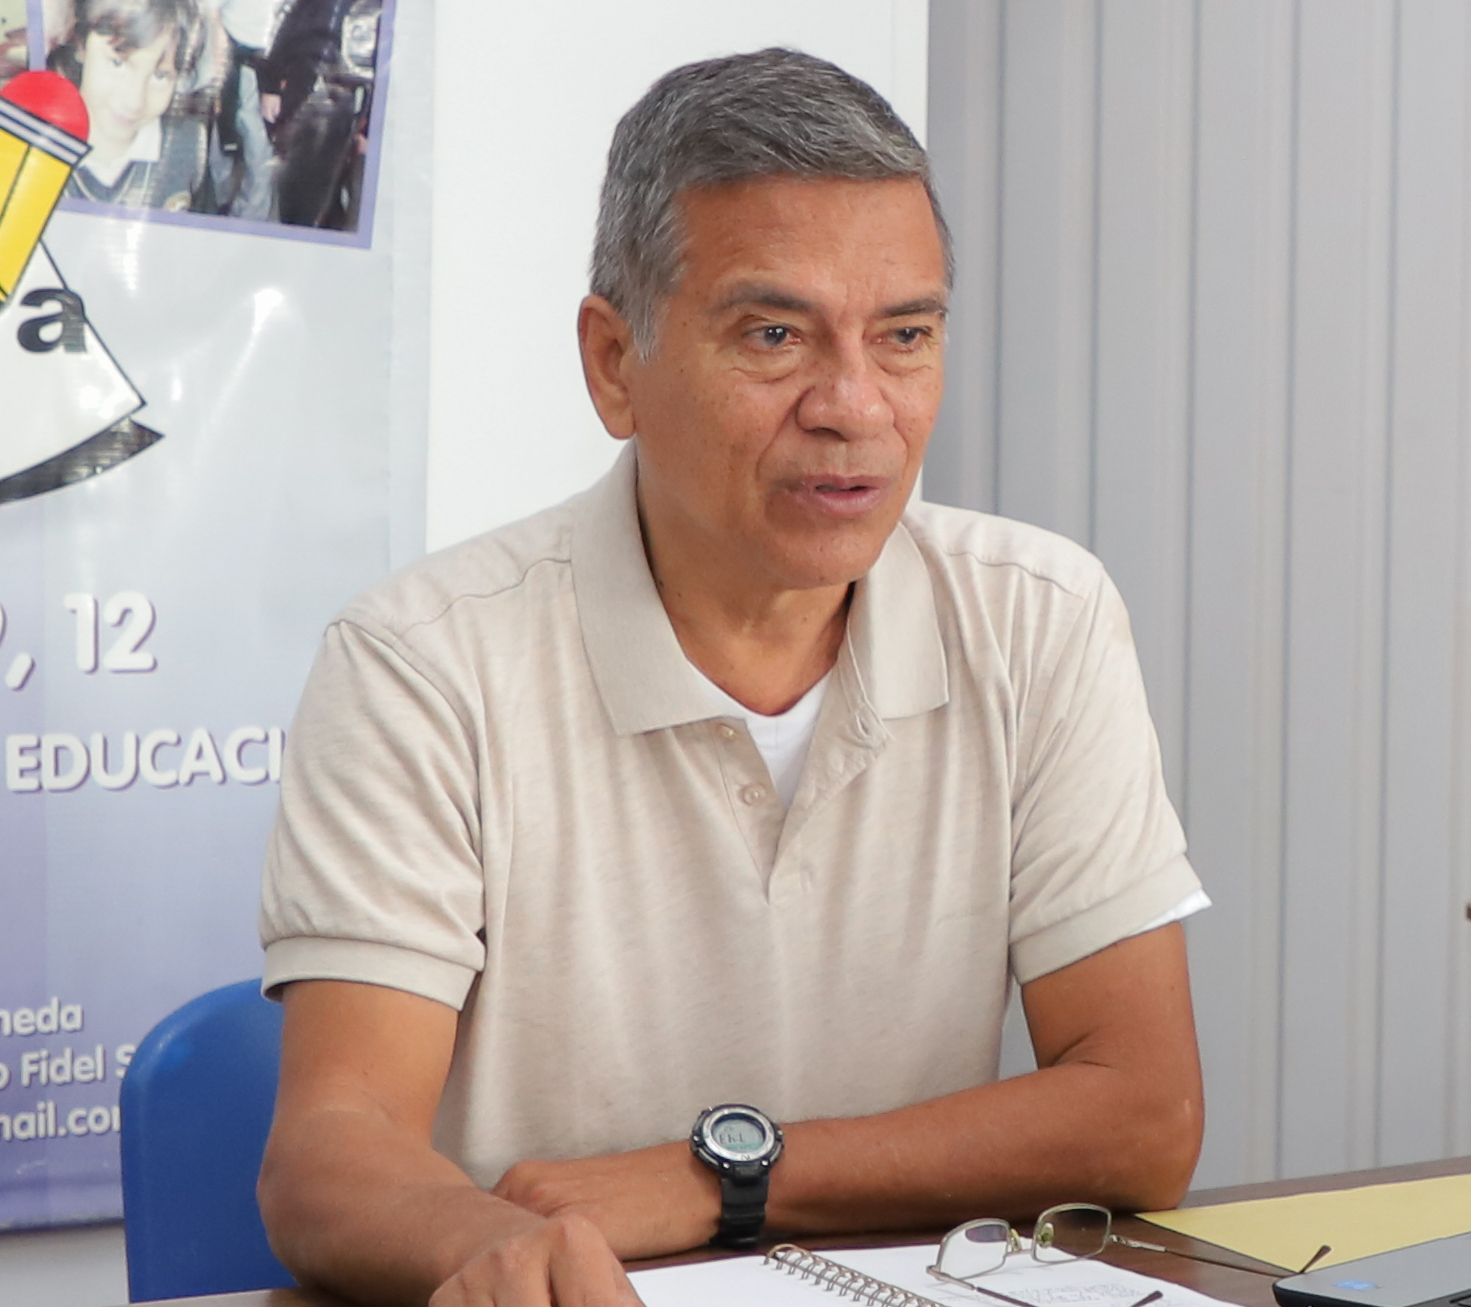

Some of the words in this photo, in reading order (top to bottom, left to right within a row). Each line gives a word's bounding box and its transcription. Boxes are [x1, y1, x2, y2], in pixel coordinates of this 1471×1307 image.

[63, 589, 158, 675] 12
[6, 725, 286, 793] EDUCACI
[21, 1043, 107, 1090] Fidel
